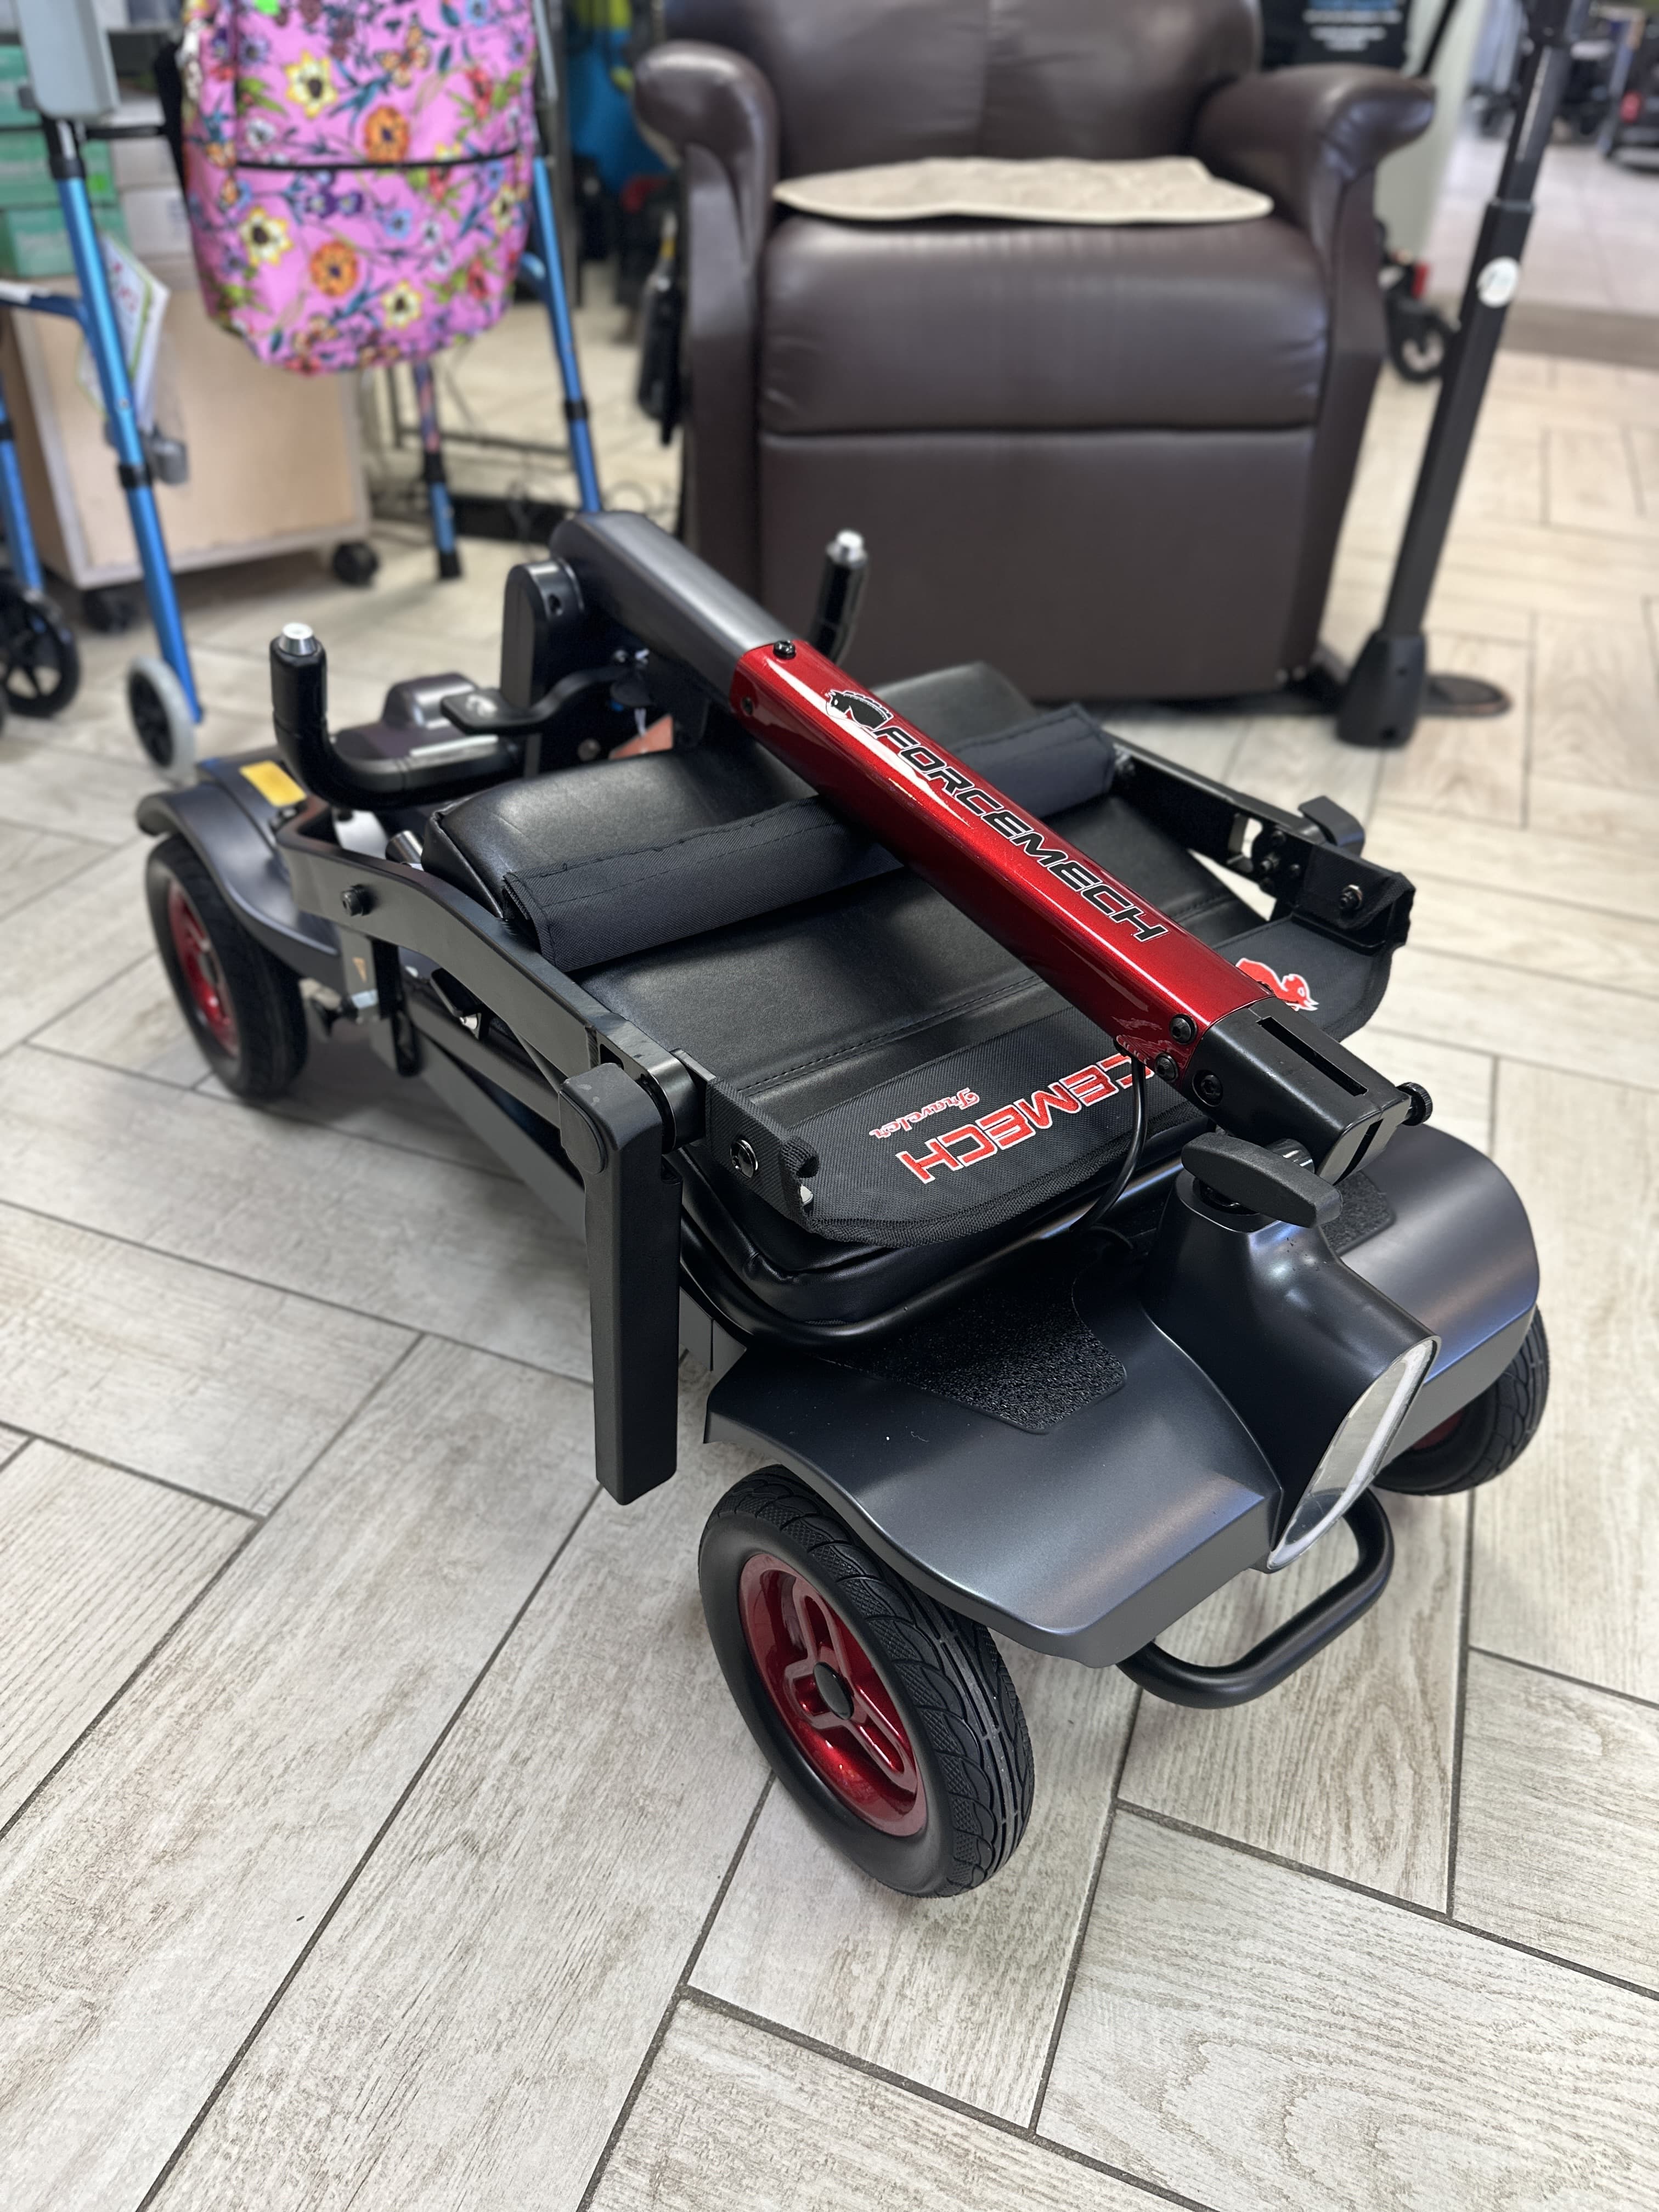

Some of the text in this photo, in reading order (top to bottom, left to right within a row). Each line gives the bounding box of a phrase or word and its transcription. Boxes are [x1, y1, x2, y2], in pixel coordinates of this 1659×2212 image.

[871, 725, 1169, 943] FORCEMECH
[868, 1087, 980, 1139] Traveler
[896, 1053, 1155, 1184] CEMECH
